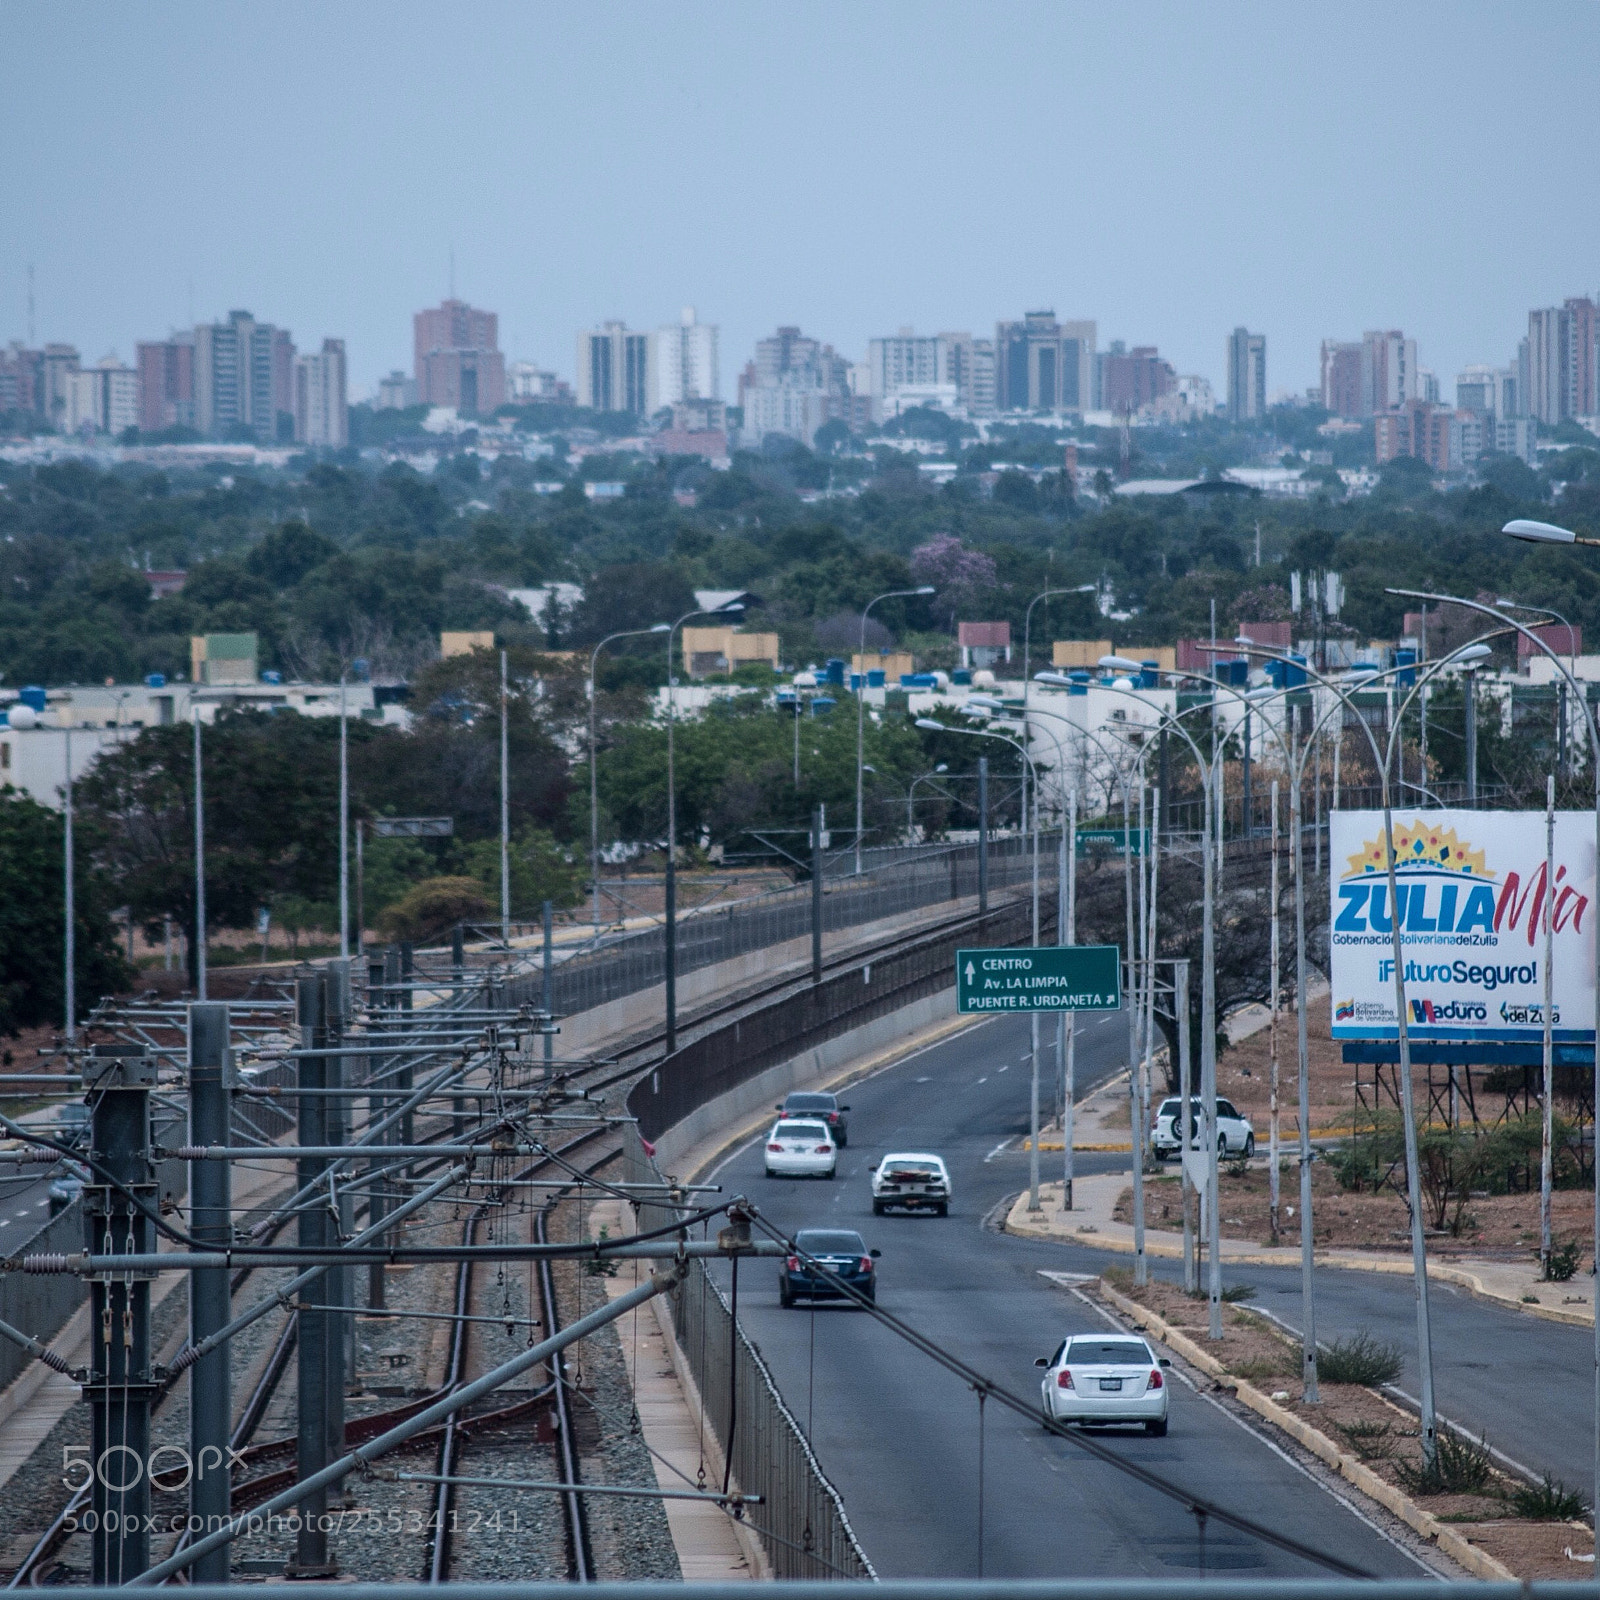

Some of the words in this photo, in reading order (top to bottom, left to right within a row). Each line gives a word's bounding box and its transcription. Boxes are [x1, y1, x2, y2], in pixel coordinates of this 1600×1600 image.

[1334, 884, 1496, 933] ZULIA
[982, 959, 1033, 970] CENTRO
[984, 978, 1004, 989] Av.
[1006, 978, 1022, 988] LA
[1025, 976, 1068, 988] LIMPIA
[968, 996, 1017, 1008] PUENTE
[1019, 996, 1031, 1007] R.
[1033, 994, 1102, 1006] URDANETA
[1355, 1008, 1394, 1016] Bolivariano
[1407, 999, 1488, 1024] Maduro
[1530, 1010, 1560, 1023] Zua
